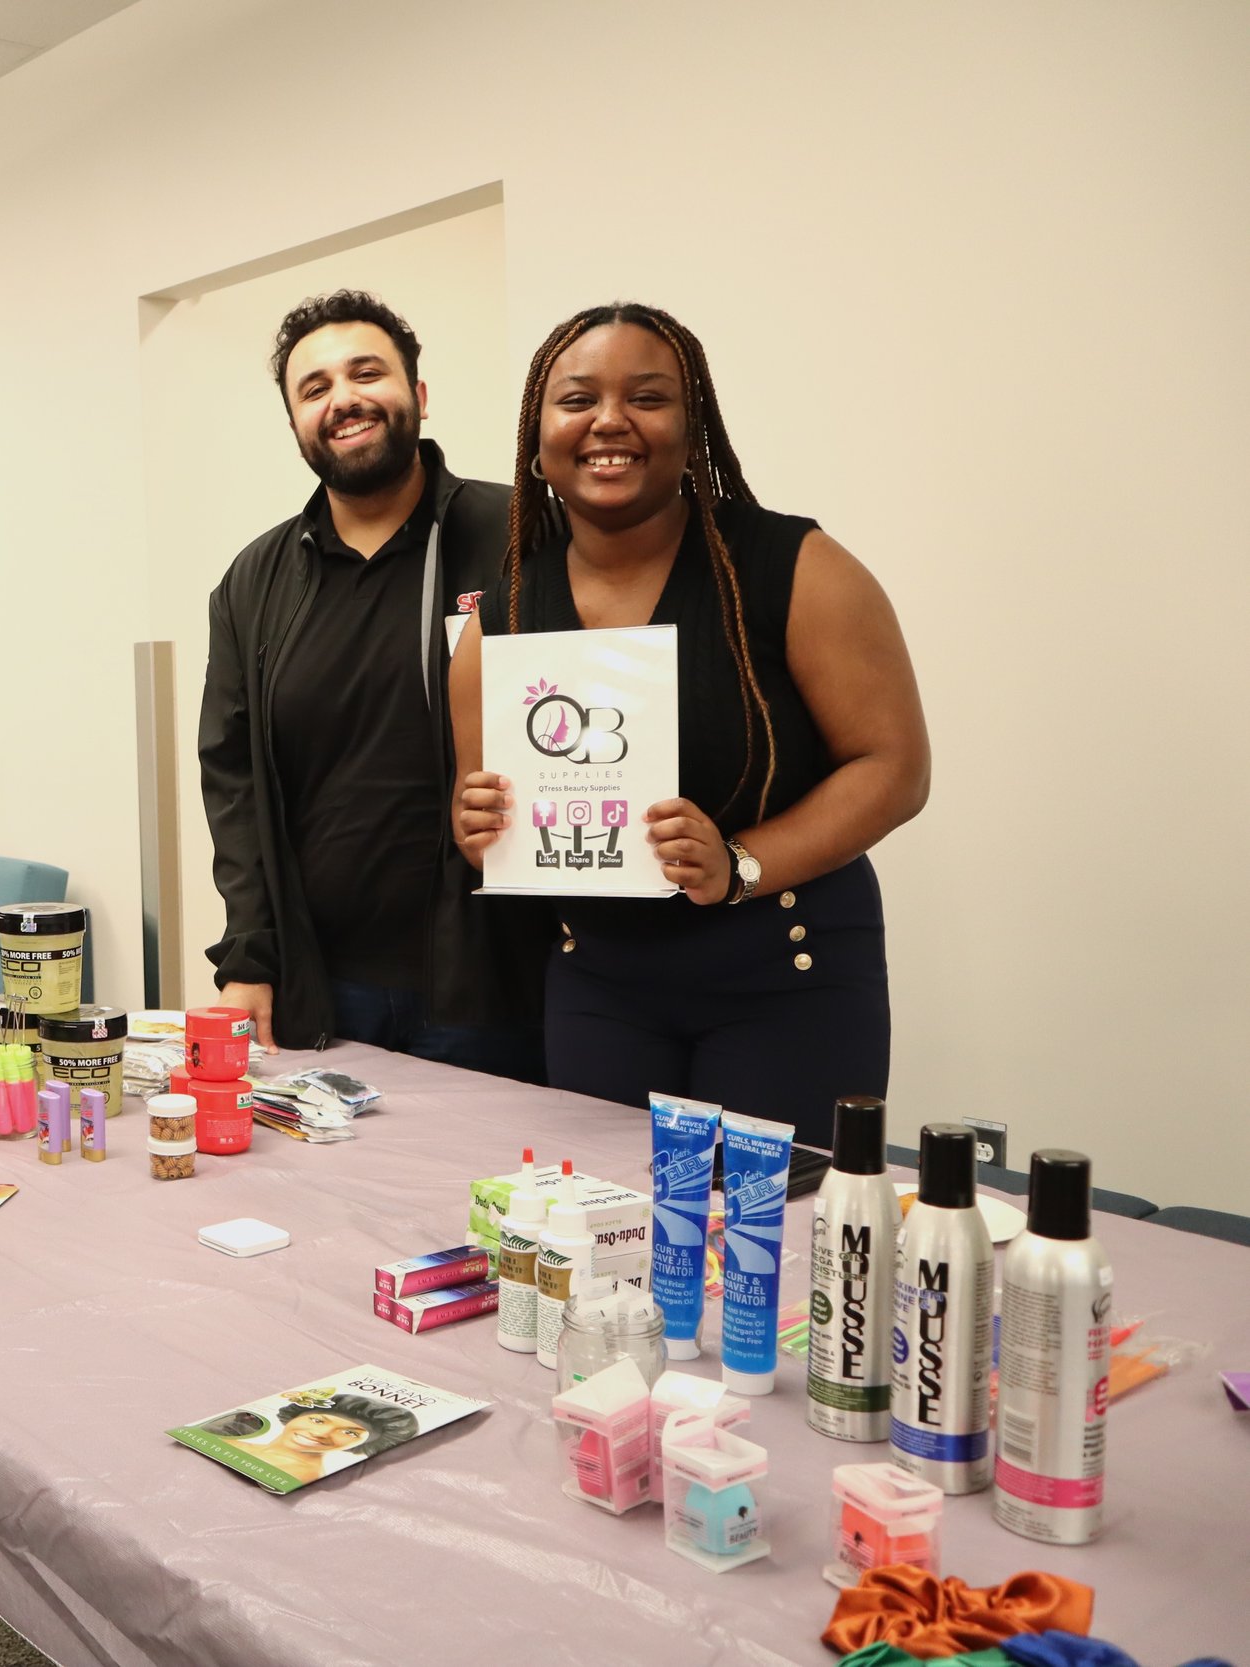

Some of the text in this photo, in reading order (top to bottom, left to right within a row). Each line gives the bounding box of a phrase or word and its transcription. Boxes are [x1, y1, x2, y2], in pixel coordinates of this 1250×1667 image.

[539, 771, 622, 779] SUPPLIES
[590, 784, 620, 792] Supplies
[539, 856, 558, 864] Like
[568, 856, 590, 864] Share
[32, 952, 52, 960] FREE
[62, 949, 75, 958] 50%
[59, 1059, 76, 1067] 50%
[77, 1058, 102, 1066] MORE
[103, 1055, 118, 1064] FREE
[53, 1067, 111, 1079] ECO
[656, 1121, 707, 1136] NATURAL HAIR
[680, 1119, 703, 1129] WAVES
[727, 1134, 783, 1152] CURLS, WAVES &
[729, 1141, 781, 1158] NATURAL HAIR
[665, 1155, 710, 1183] CURL
[737, 1178, 784, 1206] CURL
[655, 1243, 688, 1257] CURL &
[813, 1245, 863, 1262] LIVE OIL
[677, 1258, 693, 1266] JEL
[813, 1253, 834, 1267] EGA
[654, 1263, 694, 1276] CTIVATOR
[813, 1262, 867, 1282] OISTURE
[726, 1270, 760, 1286] CURL &
[748, 1286, 766, 1295] JEL
[662, 1296, 682, 1305] Argan
[725, 1291, 766, 1306] CTIVATOR
[842, 1224, 870, 1380] MOUSSE
[920, 1301, 930, 1310] &
[739, 1311, 756, 1319] Frizz
[735, 1318, 754, 1326] Olive
[732, 1325, 754, 1336] Argan
[755, 1328, 765, 1336] Oil
[747, 1337, 763, 1345] Free
[918, 1259, 949, 1427] MOUSSE
[347, 1381, 428, 1409] BONNET
[362, 1377, 436, 1404] WIDE BAND
[177, 1429, 288, 1486] STYLES TO FIT YOUR LIFE
